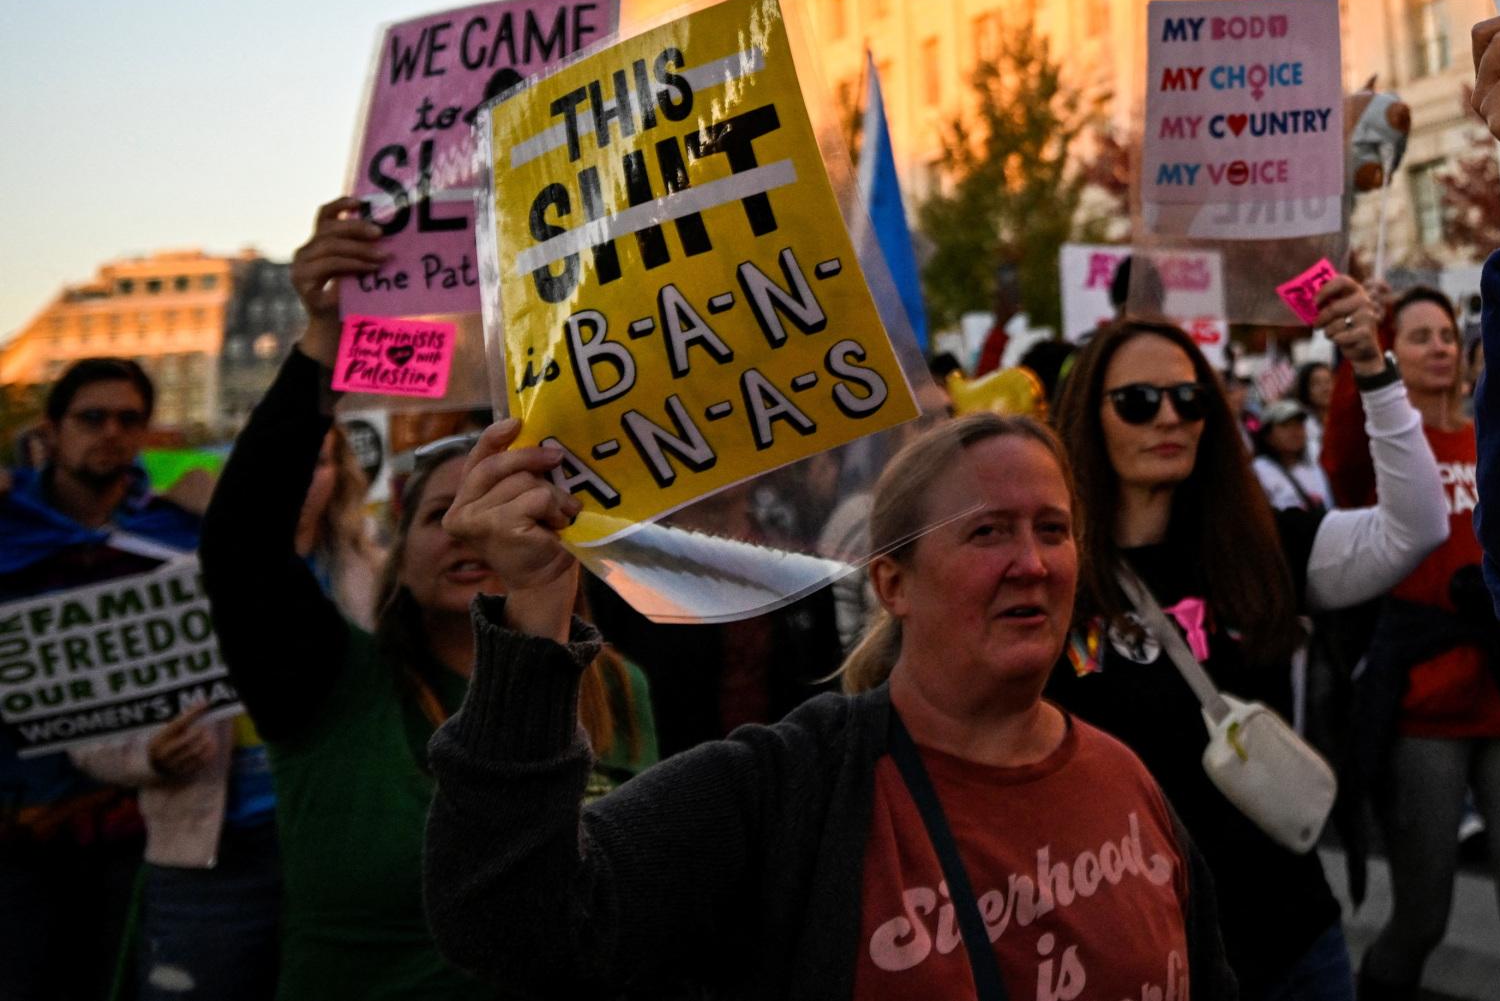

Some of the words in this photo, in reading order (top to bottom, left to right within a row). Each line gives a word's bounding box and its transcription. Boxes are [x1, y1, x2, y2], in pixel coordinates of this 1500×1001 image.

[389, 20, 454, 85] WE
[459, 3, 597, 71] CAME
[1162, 17, 1205, 42] MY
[1210, 14, 1288, 40] BODY
[551, 47, 694, 162] THIS
[1160, 67, 1205, 91] MY
[1209, 62, 1303, 101] CHOICE
[411, 96, 462, 132] to
[1158, 115, 1203, 140] MY
[1155, 163, 1202, 186] MY
[1206, 159, 1289, 186] VOICE
[528, 103, 781, 304] SHIT
[351, 321, 445, 349] Feminists
[515, 348, 561, 394] is
[565, 247, 842, 410] B-A-N-
[343, 359, 438, 387] Palestine
[539, 338, 889, 509] A-N-A-S
[28, 577, 204, 636] FAMIL
[38, 608, 212, 677] FREEDO
[3, 679, 94, 713] OUR
[107, 650, 224, 694] FUTU
[19, 698, 174, 742] WOMEN'S
[869, 812, 1172, 972] Sierhood
[1036, 933, 1087, 1001] is
